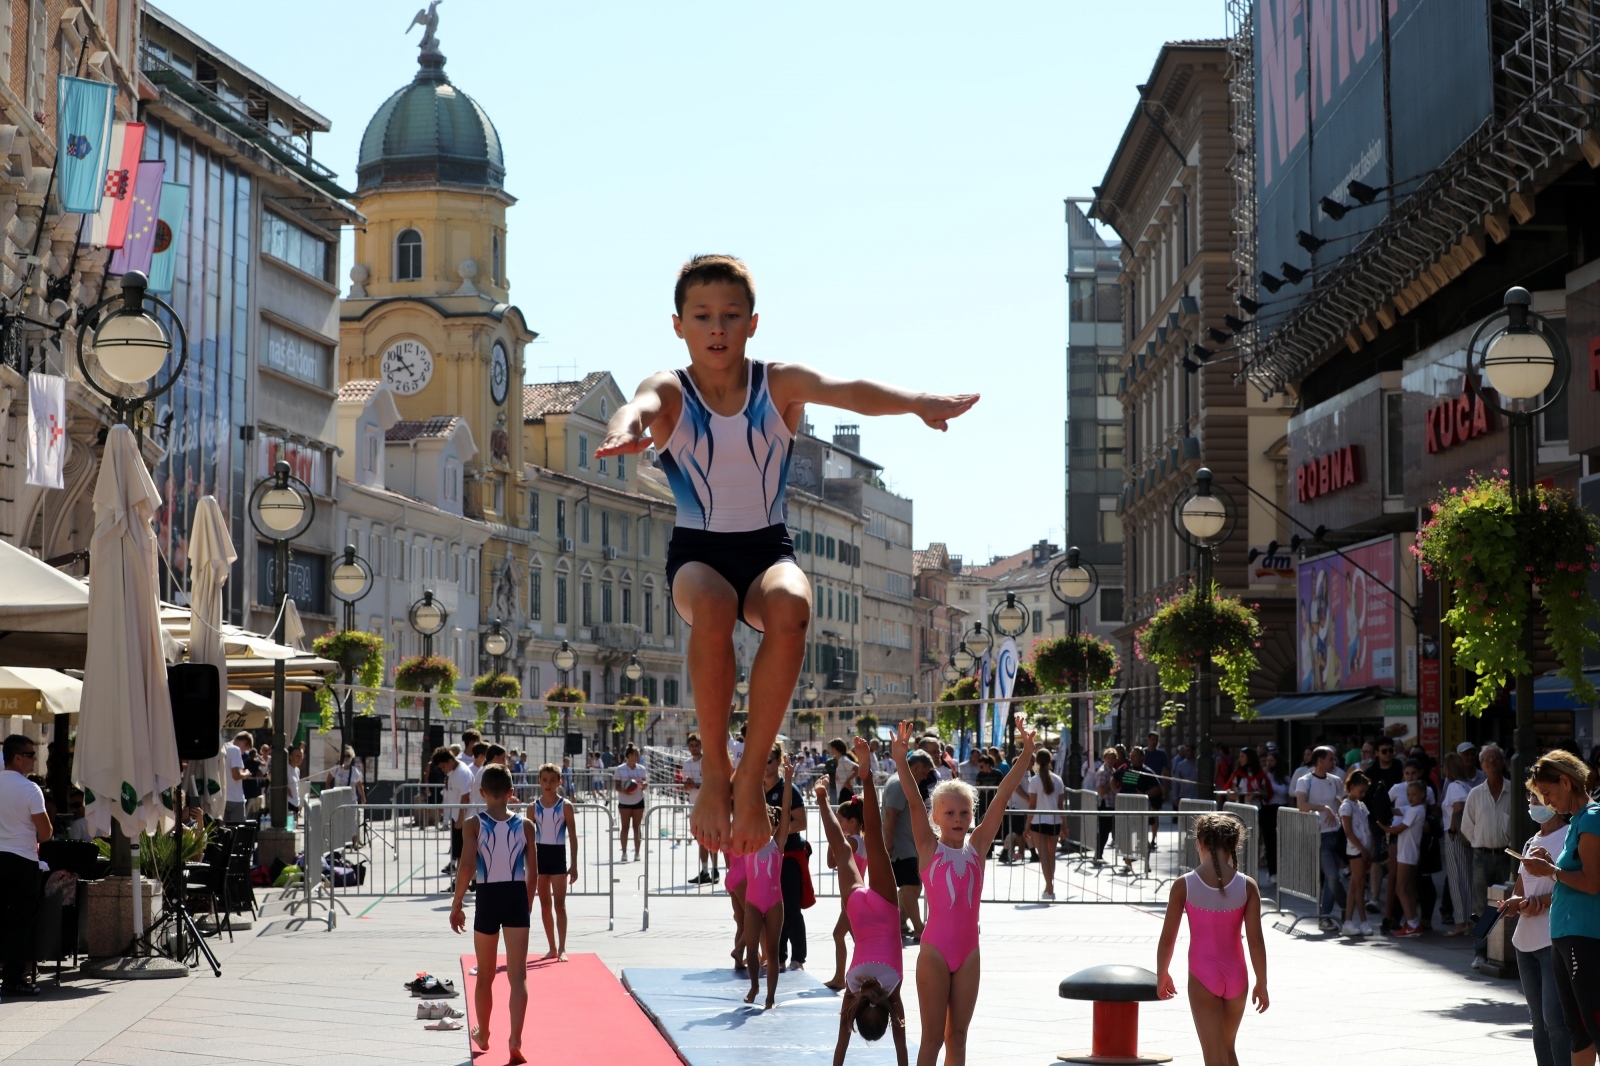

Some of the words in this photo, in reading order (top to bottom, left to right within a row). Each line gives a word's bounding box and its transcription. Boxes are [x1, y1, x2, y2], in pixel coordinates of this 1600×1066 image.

[403, 342, 413, 354] 12
[269, 336, 286, 367] naš
[297, 345, 317, 379] dom
[387, 351, 396, 361] 10
[420, 351, 427, 361] 2
[383, 362, 391, 373] 9
[424, 361, 431, 372] 3
[387, 373, 394, 384] 8
[420, 372, 426, 382] 4
[395, 381, 402, 391] 7
[403, 382, 410, 393] 6
[412, 380, 419, 391] 5
[1297, 444, 1355, 503] ROBNA
